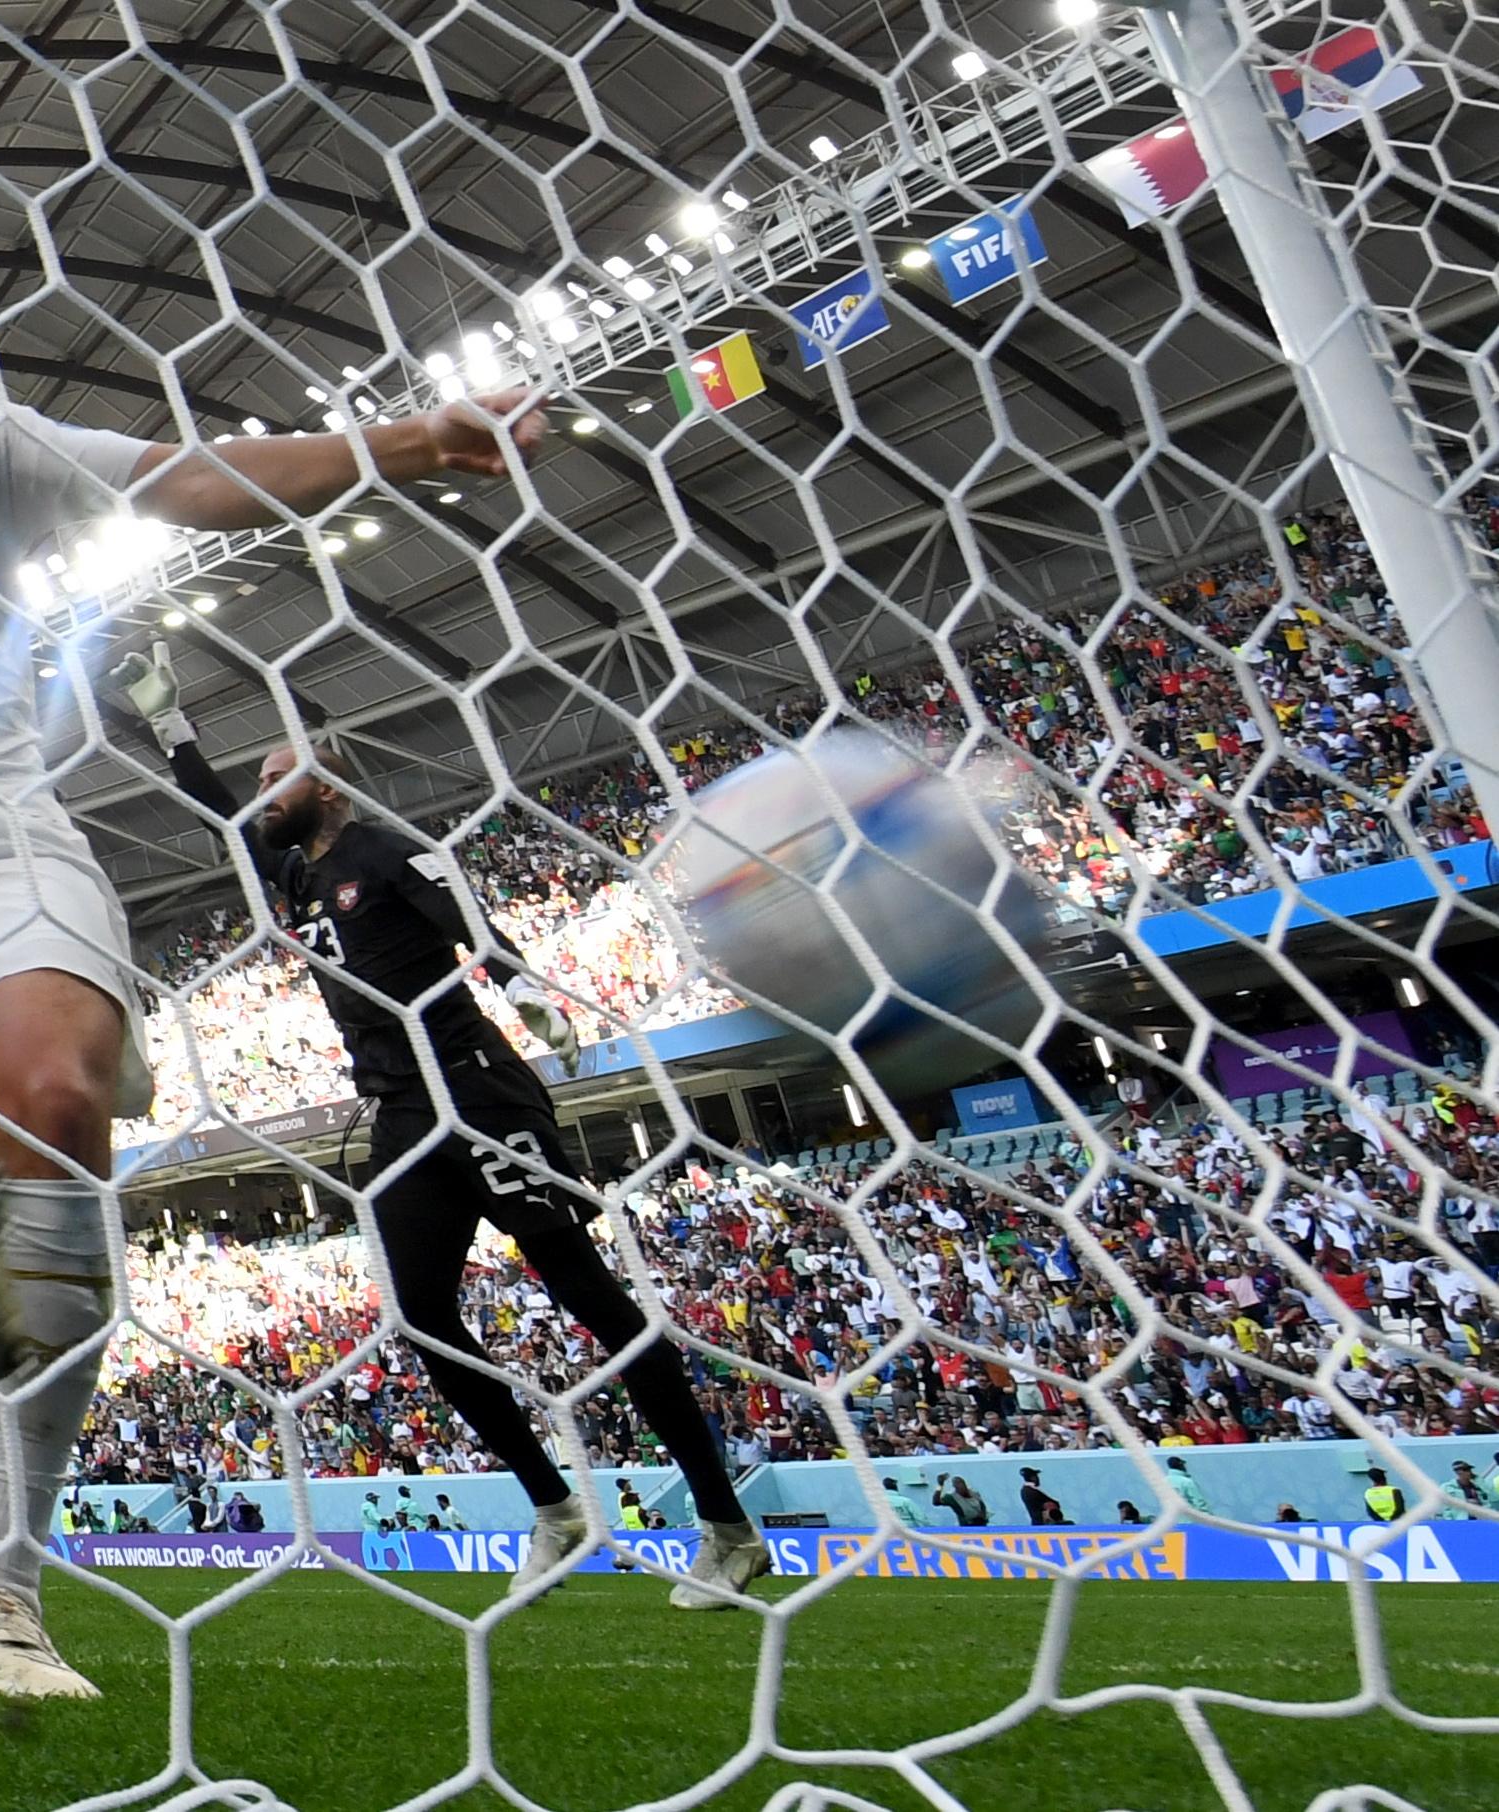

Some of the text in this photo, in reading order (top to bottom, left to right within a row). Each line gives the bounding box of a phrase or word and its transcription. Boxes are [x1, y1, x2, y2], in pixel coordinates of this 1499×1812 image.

[951, 227, 1025, 278] FIFA
[296, 916, 346, 967] 23
[253, 1116, 306, 1137] CAMEROON
[324, 1107, 336, 1125] 2
[470, 1131, 556, 1195] 23
[94, 1547, 125, 1566] FIFA
[123, 1547, 176, 1567] WORLD
[176, 1549, 204, 1568] CUP
[435, 1534, 536, 1573] VIS
[1261, 1525, 1462, 1582] VISA
